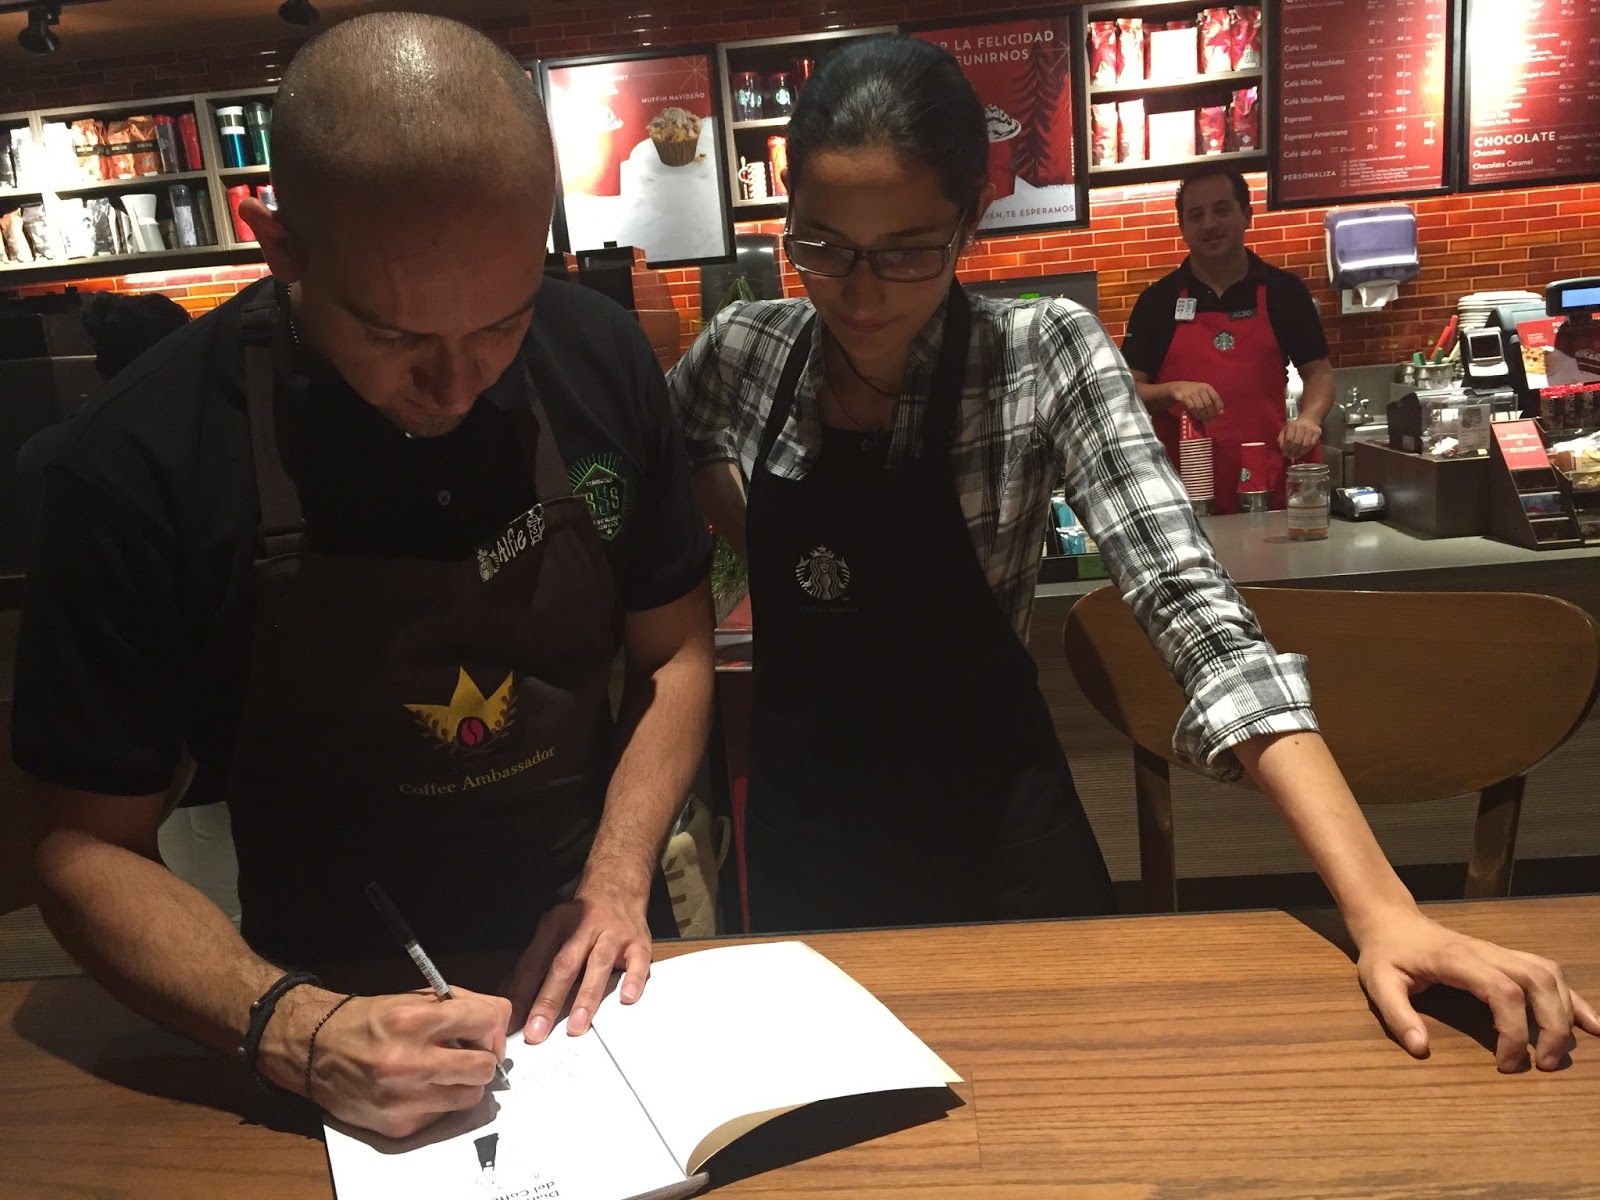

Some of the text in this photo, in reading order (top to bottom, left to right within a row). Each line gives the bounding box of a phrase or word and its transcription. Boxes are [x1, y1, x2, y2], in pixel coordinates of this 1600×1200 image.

[1284, 25, 1322, 34] Cappuccino
[954, 40, 971, 51] LA
[977, 30, 1054, 48] FELICIDAD
[1284, 44, 1299, 52] Café
[955, 48, 1029, 66] EUNIRNOS
[1284, 59, 1345, 70] Caramel Macchiato
[1284, 78, 1323, 88] Café Mocha
[641, 91, 705, 103] MUFFIN NAVIDEÑO
[1284, 94, 1345, 106] Café Mocha Blanco
[1284, 115, 1313, 124] Espresso
[1284, 129, 1348, 142] Espresso Americano
[1474, 131, 1556, 148] CHOCOLATE
[1284, 150, 1299, 158] Café
[1300, 149, 1311, 157] del
[1473, 148, 1506, 158] Chocolate
[1472, 158, 1534, 170] Chocolate Caramel
[1284, 170, 1337, 181] PERSONALIZA
[1006, 210, 1018, 218] TE
[1020, 204, 1074, 217] ESPERAMOS
[496, 527, 527, 563] Alfie
[399, 746, 556, 795] Coffee Ambassador
[533, 1181, 555, 1193] del
